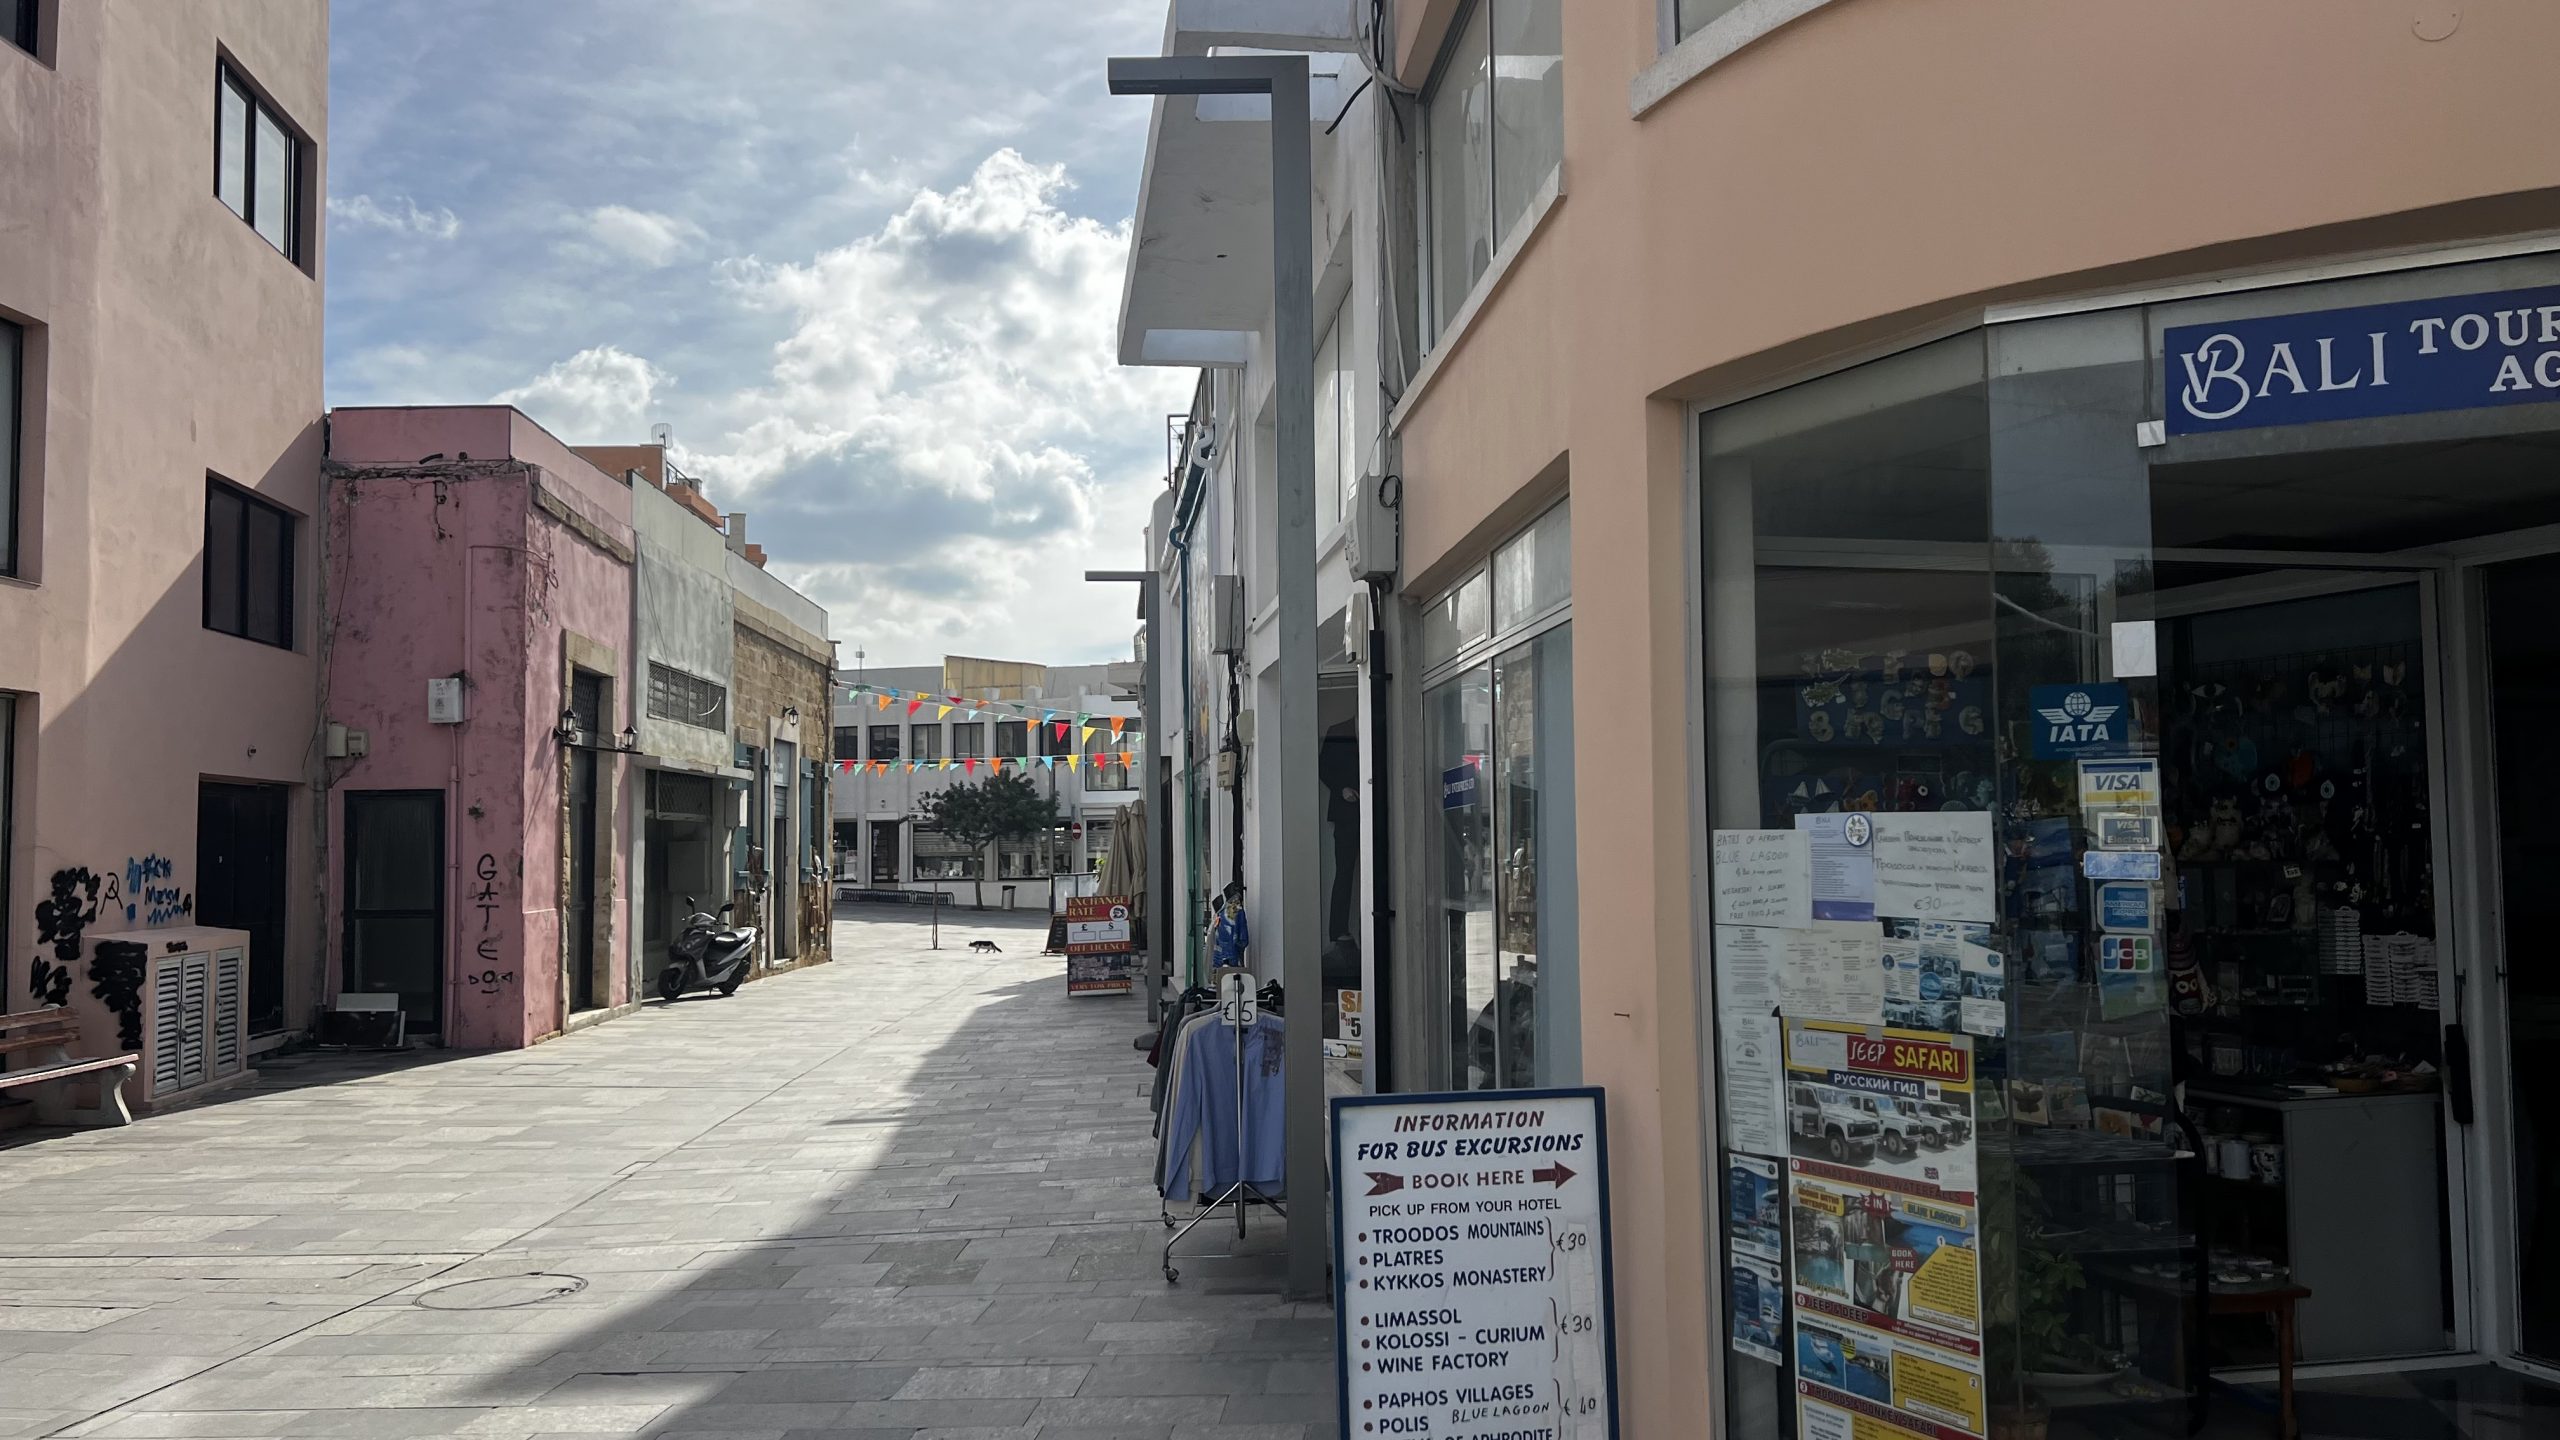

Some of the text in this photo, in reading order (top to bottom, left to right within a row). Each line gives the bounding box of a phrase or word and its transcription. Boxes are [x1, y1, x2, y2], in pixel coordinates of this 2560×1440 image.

[2049, 724, 2110, 743] IATA
[2094, 773, 2141, 791] VISA
[2116, 820, 2140, 832] VISA
[2107, 835, 2149, 844] Electron
[1069, 896, 1126, 906] EXCHANGE
[1069, 906, 1095, 916] RATE
[1070, 943, 1126, 952] OFF LICENCE
[2103, 947, 2148, 960] JCB
[1849, 1040, 1959, 1074] JEEP SAFARI
[1834, 1072, 1919, 1096] РУССКИЙ ГИД
[1394, 1110, 1545, 1133] INFORMATION
[1358, 1133, 1584, 1160] FOR BUS EXCURSIONS
[1412, 1169, 1525, 1189] BOOK HERE
[1369, 1198, 1562, 1217] PICK UP FROM YOUR HOTEL
[1864, 1198, 1870, 1208] 2
[1873, 1199, 1883, 1210] IN
[1373, 1219, 1545, 1244] TROODOS MOUNTAINS
[1556, 1231, 1587, 1253] €30
[1373, 1249, 1444, 1268] PLATRES
[1891, 1249, 1913, 1259] BOOK
[1895, 1260, 1915, 1269] HERE
[1373, 1266, 1546, 1291] KYKKOS MONASTERY
[1375, 1308, 1462, 1328] LIMASSOL
[1808, 1298, 1831, 1313] JEEP
[1842, 1305, 1869, 1322] DEEP
[1560, 1317, 1593, 1336] €30
[1376, 1330, 1450, 1350] KOLOSSI
[1475, 1325, 1545, 1346] CURIUM
[1377, 1350, 1509, 1374] WINE FACTORY
[1378, 1383, 1535, 1410] PAPHOS VILLAGES
[1379, 1416, 1429, 1434] POLIS
[1451, 1406, 1488, 1425] BLUE
[1902, 1411, 1938, 1436] SAFARI
